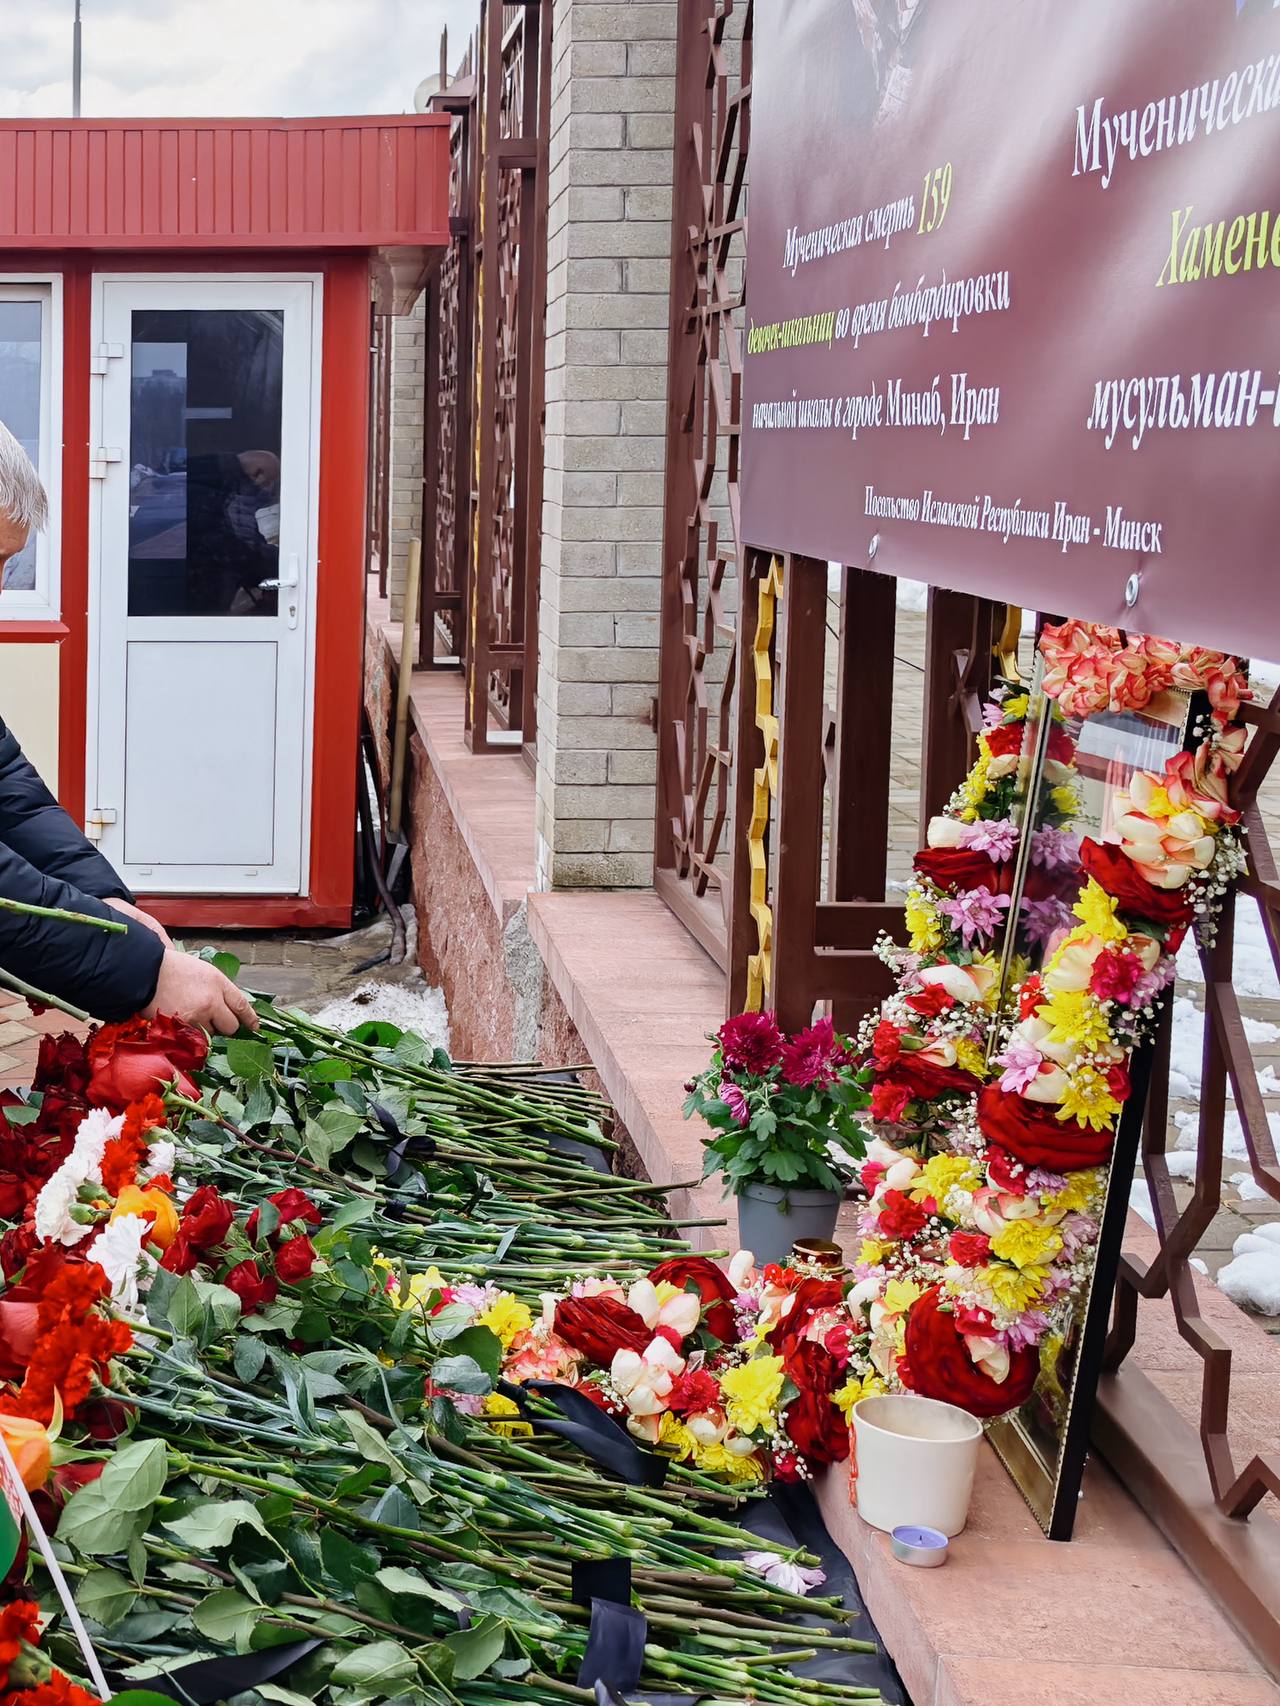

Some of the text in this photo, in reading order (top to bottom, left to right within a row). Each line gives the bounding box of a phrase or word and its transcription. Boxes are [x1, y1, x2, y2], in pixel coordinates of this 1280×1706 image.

[782, 162, 952, 277] Мученическая смерть 159
[748, 310, 835, 354] девочек-школьниц
[835, 307, 850, 339] во
[851, 299, 888, 349] время
[752, 373, 1000, 440] начальной школы в городе Минаб, Иран
[864, 486, 919, 522] Посольство
[920, 490, 980, 530] Исламской
[980, 495, 1050, 544] Республики
[1051, 501, 1090, 552] Иран
[1103, 506, 1162, 553] Минск
